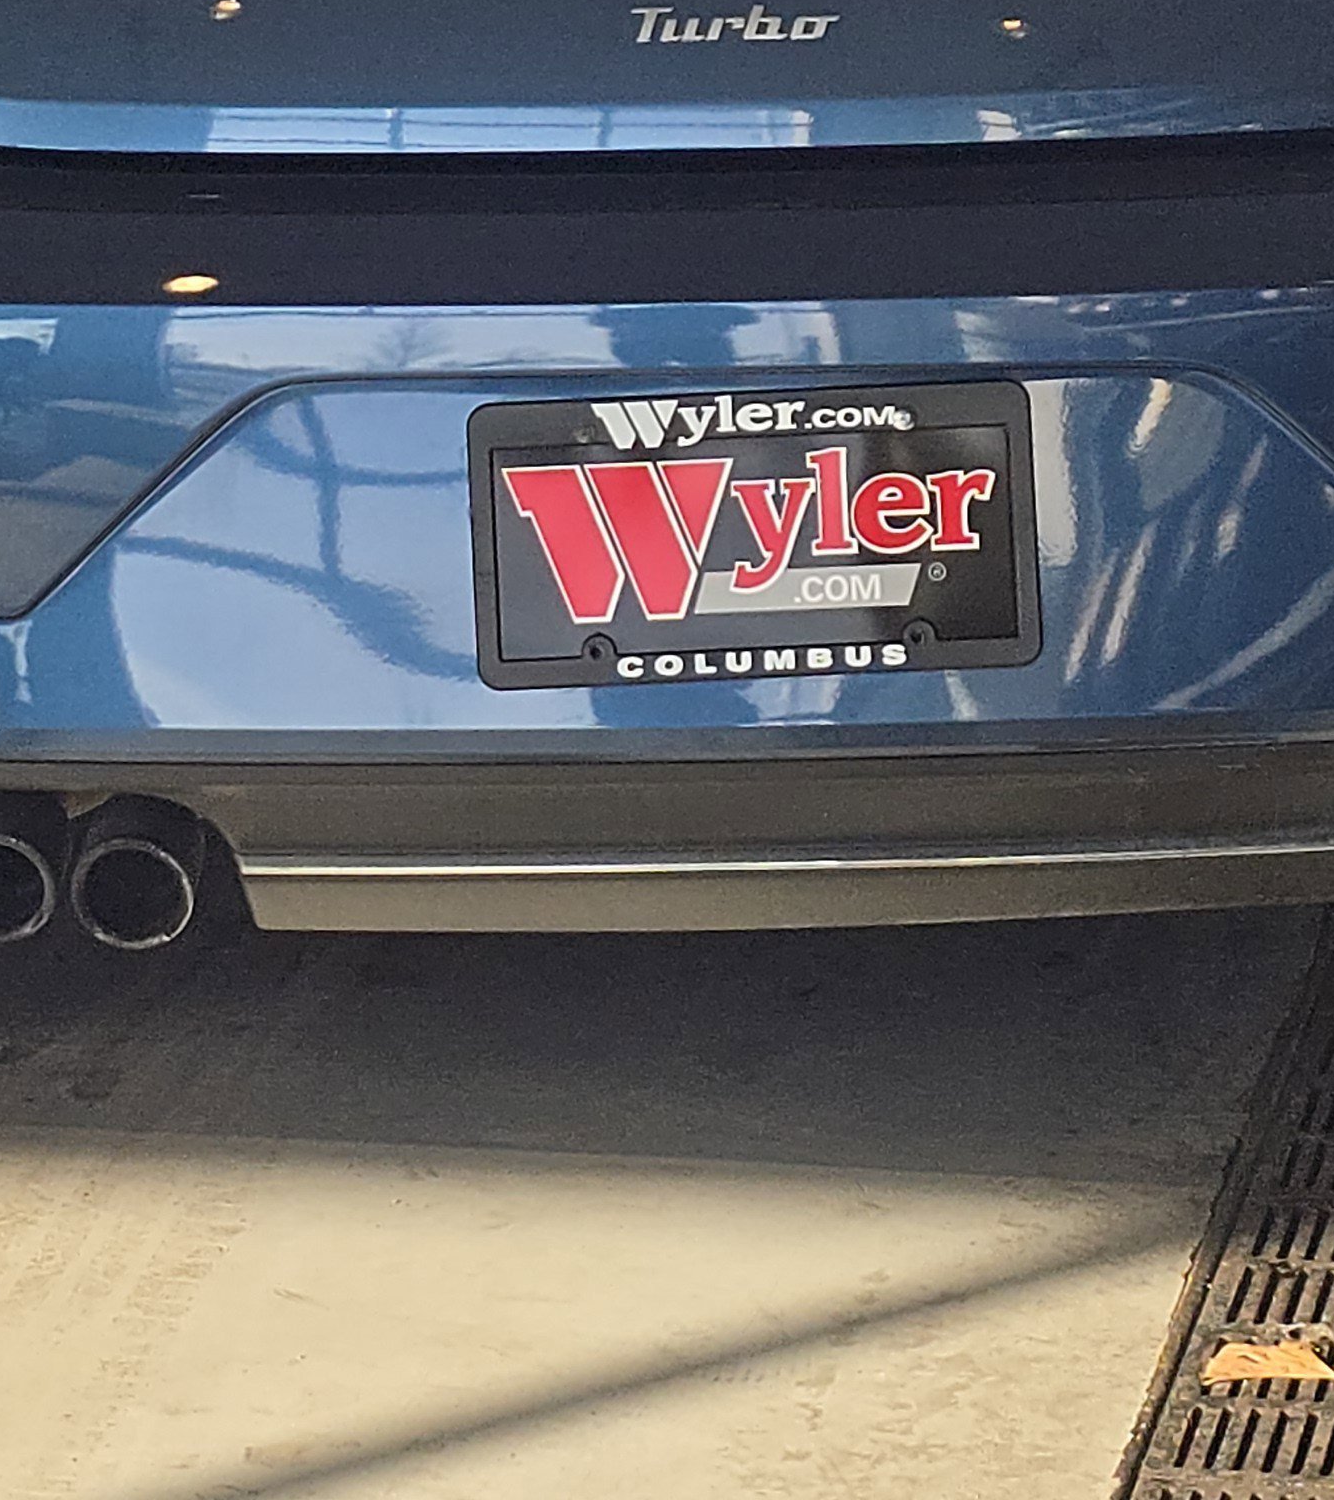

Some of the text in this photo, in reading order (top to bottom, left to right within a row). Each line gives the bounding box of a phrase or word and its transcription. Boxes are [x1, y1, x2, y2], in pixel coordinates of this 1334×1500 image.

[630, 5, 840, 43] Turbo
[500, 446, 996, 625] Wyler
[616, 643, 908, 679] COLUMBUS
